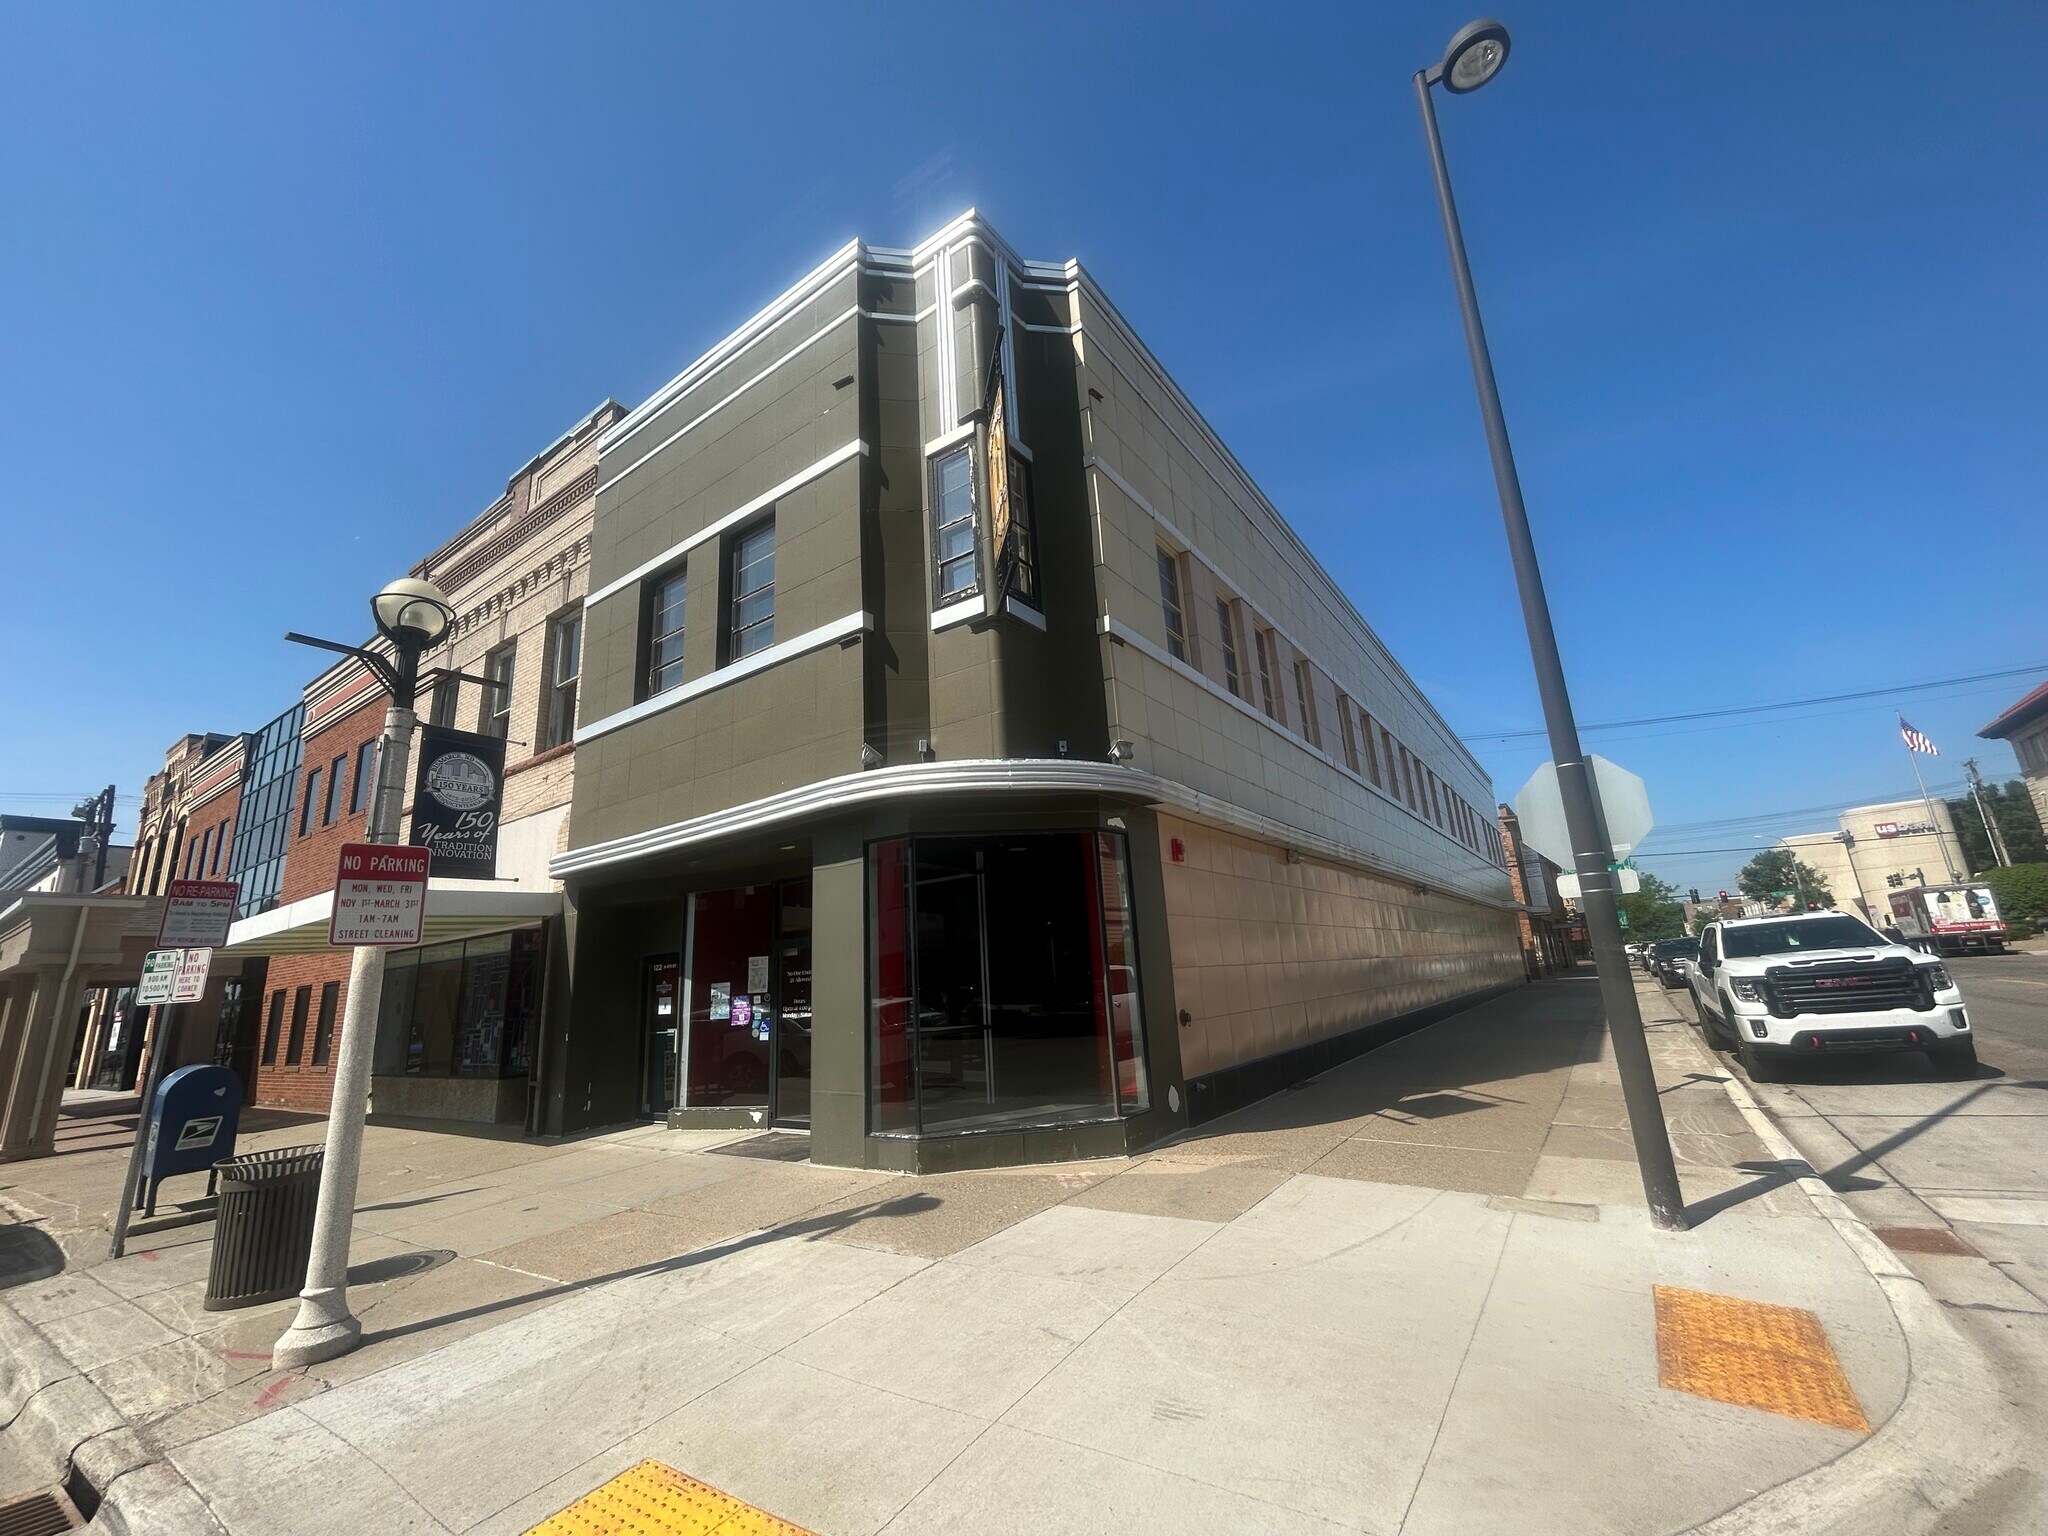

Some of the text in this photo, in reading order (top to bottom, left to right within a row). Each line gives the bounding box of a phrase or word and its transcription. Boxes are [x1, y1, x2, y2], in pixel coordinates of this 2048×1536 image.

[439, 781, 484, 793] 150 YEARS
[455, 812, 494, 829] 150
[418, 821, 494, 845] Years of
[434, 841, 493, 853] TRADITION
[430, 849, 492, 860] NNOVATION
[343, 856, 425, 873] NO PARKING
[172, 885, 236, 898] NO RE-PARKING
[351, 884, 412, 894] MON, WED, FRI
[172, 899, 193, 907] 8AM
[210, 900, 230, 908] 5PM
[340, 898, 356, 908] NOV
[338, 929, 414, 939] STREET CLEANING
[145, 959, 156, 967] 90
[189, 953, 199, 963] NO
[177, 964, 206, 975] PARKING
[178, 976, 191, 984] HERE
